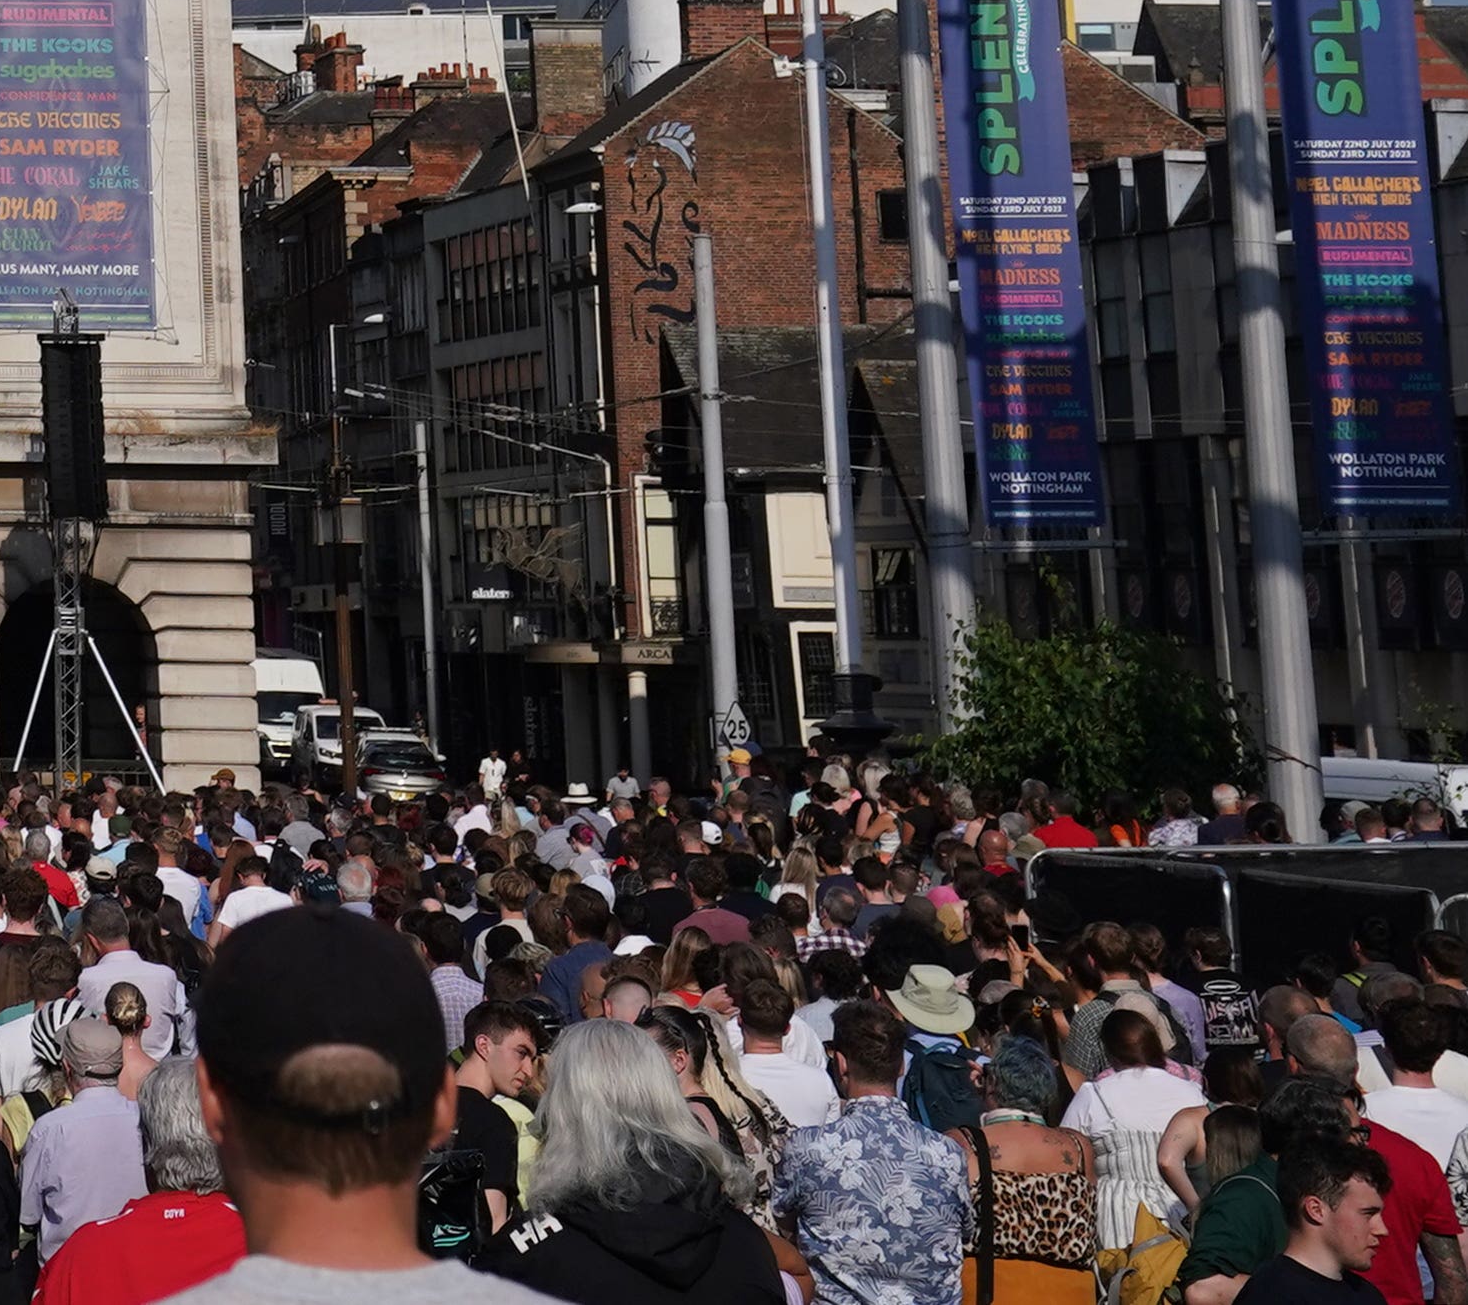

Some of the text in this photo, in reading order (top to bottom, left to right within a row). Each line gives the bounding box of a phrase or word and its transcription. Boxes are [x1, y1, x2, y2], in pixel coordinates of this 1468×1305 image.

[3, 8, 108, 20] RUDIMENTAL
[0, 38, 114, 54] THE KOOKS
[0, 58, 115, 83] sugababes
[0, 91, 118, 102] CONFIDENCE MAN
[36, 111, 122, 129] VACCINES
[52, 139, 121, 156] RYDER
[1293, 139, 1417, 149] SATURDAY 22ND JULY 2023
[1300, 150, 1411, 159] SUNDAY 23RD JULY 2023
[24, 165, 82, 188] CORAL
[97, 165, 130, 177] JAKE
[88, 178, 139, 189] SHEARS
[1332, 176, 1422, 193] GALLAGHER'S
[959, 197, 1002, 205] SATURDAY
[1312, 193, 1412, 205] HIGH FLYING BIRDS
[1315, 222, 1410, 241] MADNESS
[1323, 250, 1408, 262] RUDIMENTAL
[20, 264, 60, 277] MANY,
[61, 265, 100, 276] MANY
[102, 265, 140, 276] MORE
[979, 268, 1061, 286] MADNESS
[1323, 274, 1414, 286] THE KOOKS
[75, 285, 149, 297] NOTTINGHAM
[1013, 314, 1064, 326] KOOKS
[1327, 352, 1423, 366] SAM RYDER
[989, 383, 1022, 396] SAM
[1330, 397, 1378, 416] DYLAN
[992, 422, 1033, 440] DYLAN
[1329, 452, 1447, 465] WOLLATON PARK
[989, 471, 1092, 482] WOLLATON PARK
[1340, 465, 1437, 478] NOTTINGHAM
[1000, 483, 1084, 494] NOTTINGHAM
[727, 719, 746, 740] 25
[509, 1212, 564, 1254] HH
